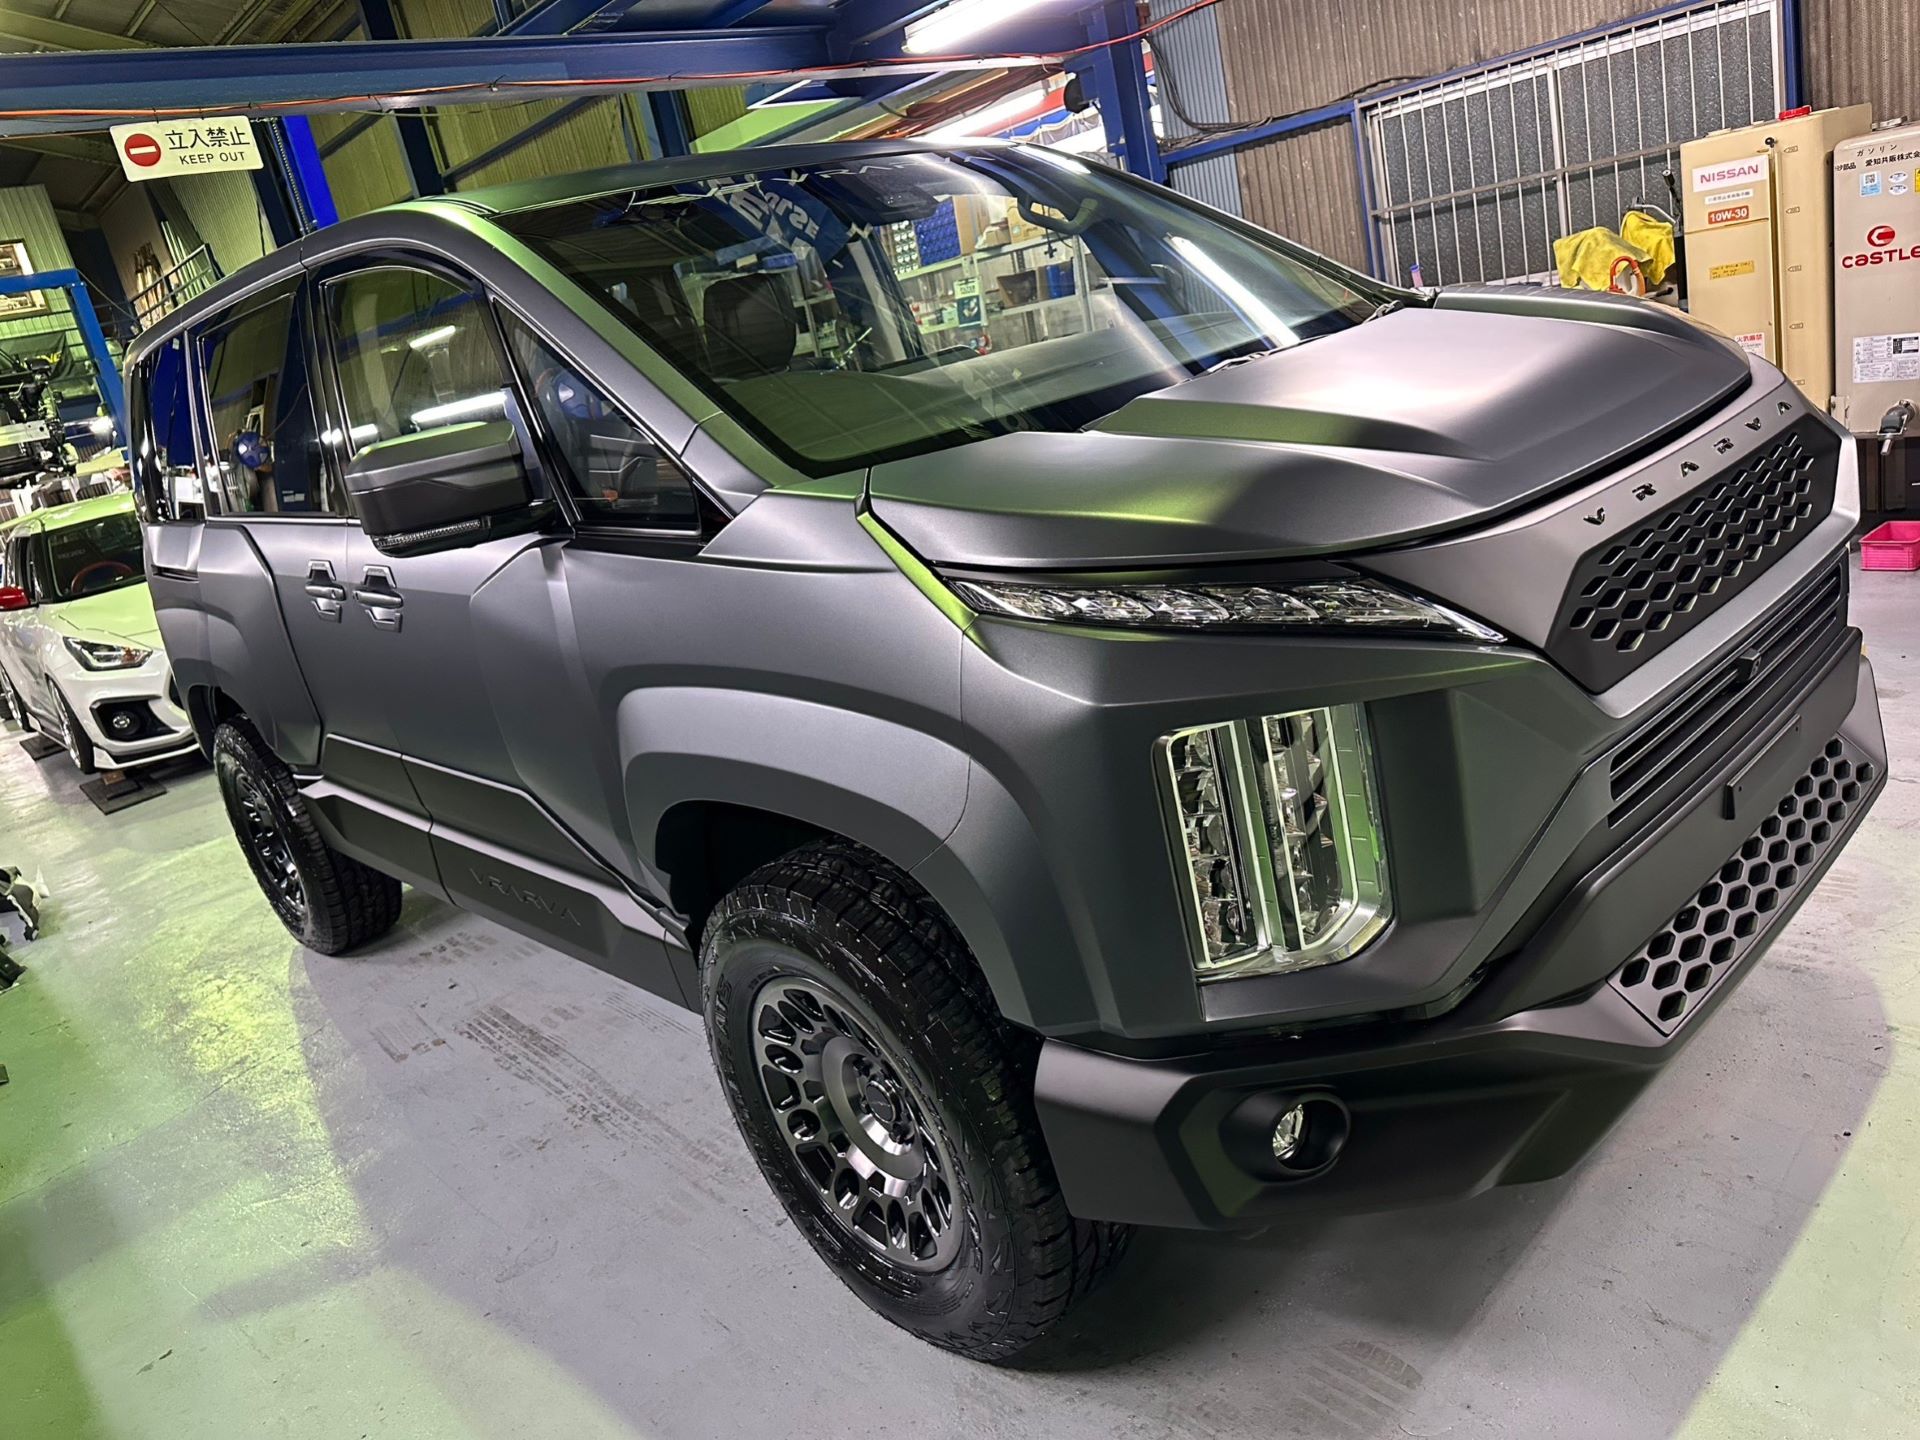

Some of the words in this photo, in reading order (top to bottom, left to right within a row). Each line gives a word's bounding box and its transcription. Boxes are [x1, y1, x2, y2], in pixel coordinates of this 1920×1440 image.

[165, 126, 250, 150] 立入禁止
[179, 153, 215, 165] KEEP
[219, 151, 246, 162] OUT
[1856, 144, 1898, 157] ガソリン
[1700, 164, 1759, 184] NISSAN
[1710, 208, 1748, 222] 10W-30
[1583, 401, 1793, 526] VRARVA
[469, 868, 581, 926] VRARVA
